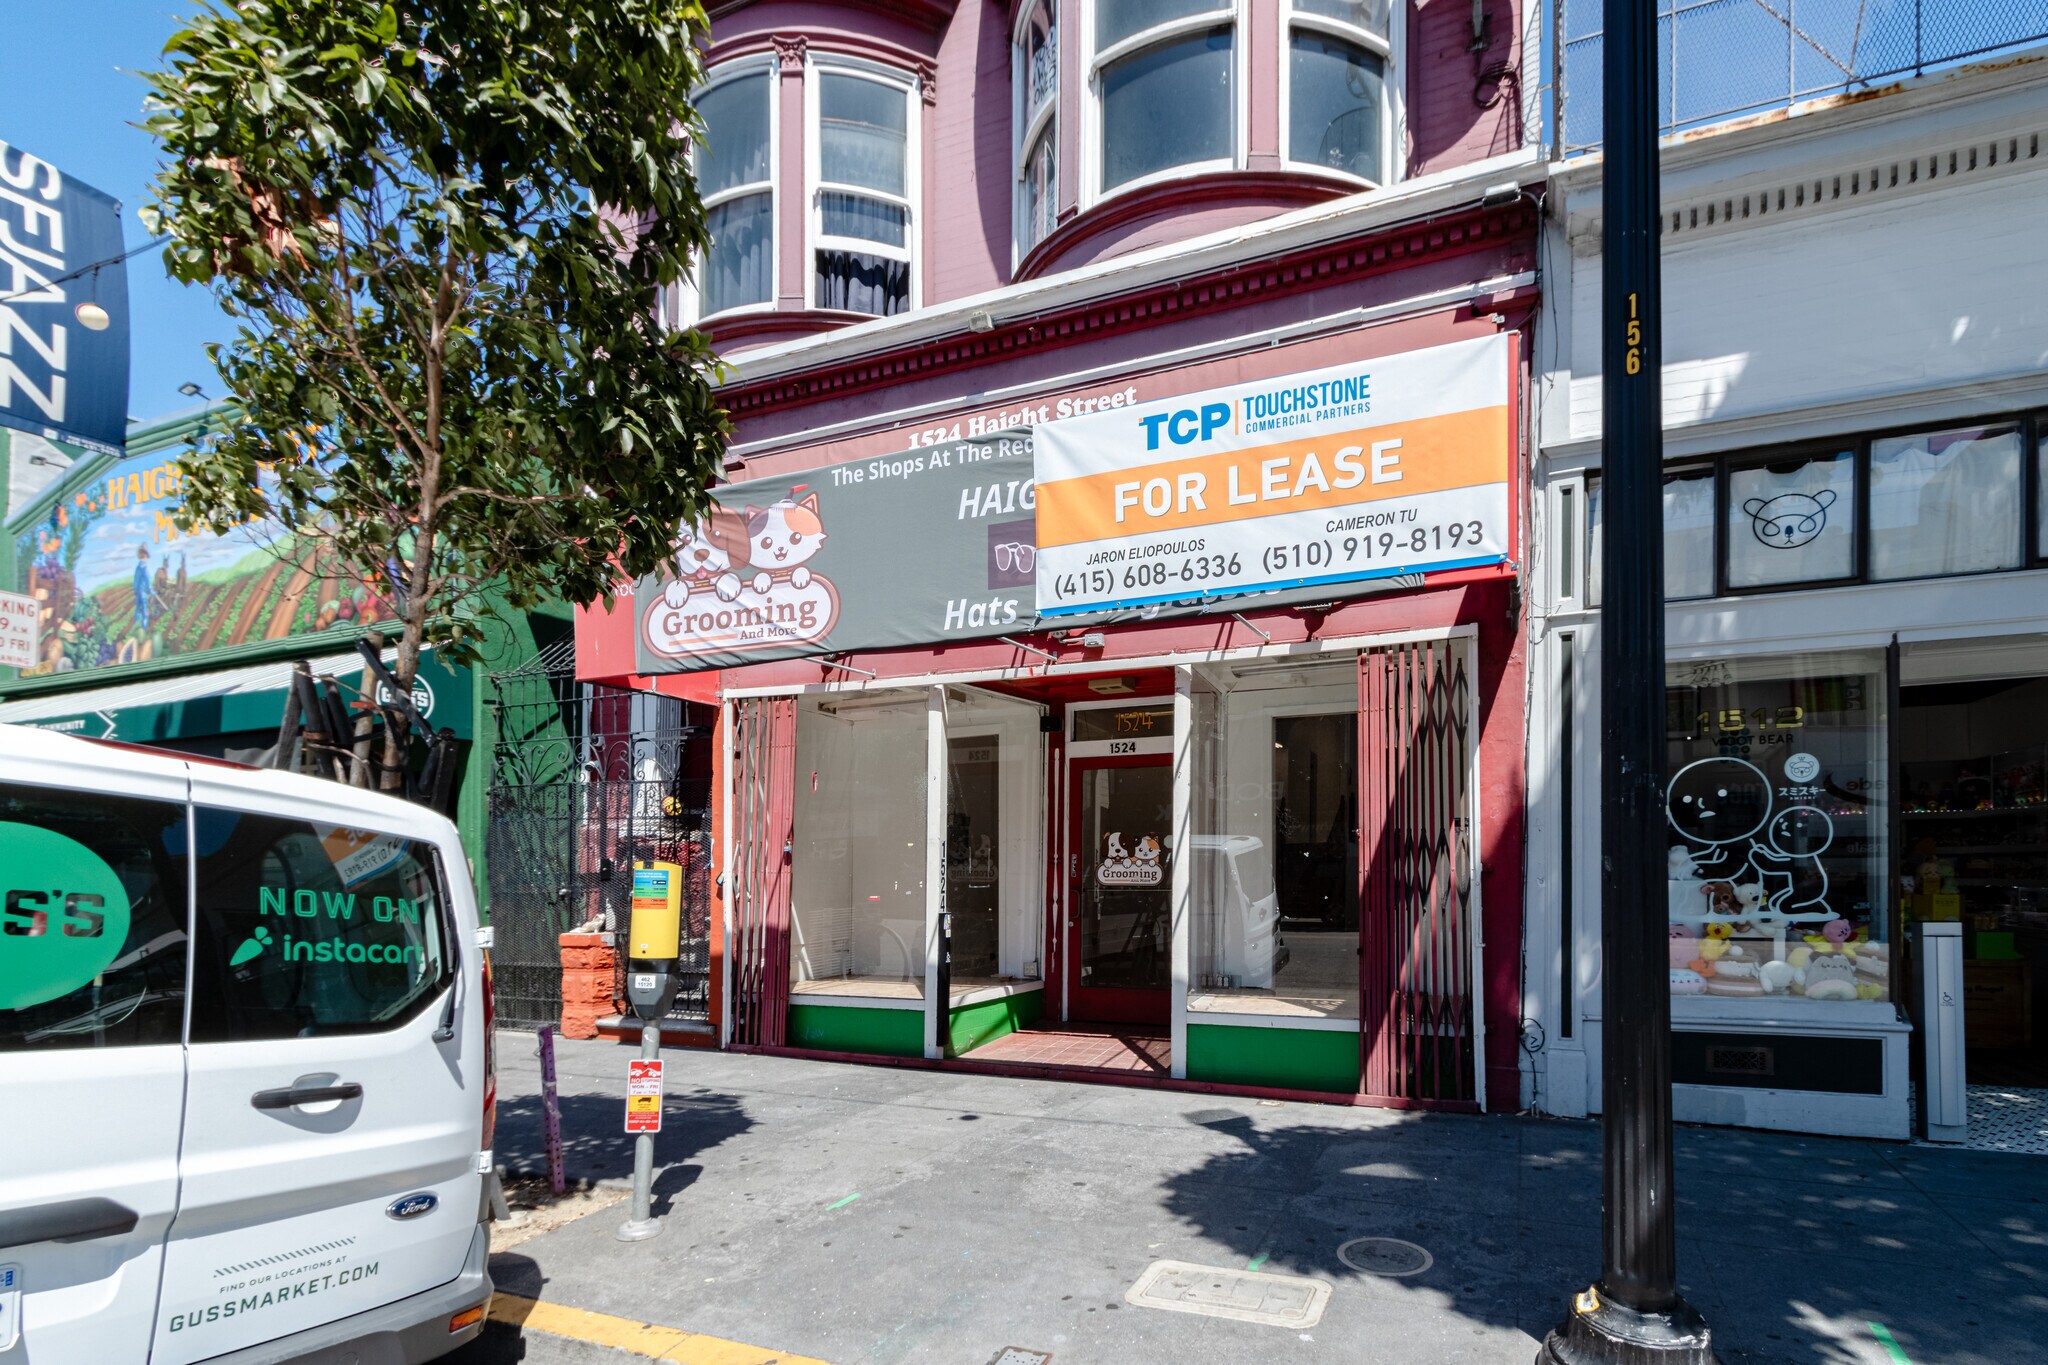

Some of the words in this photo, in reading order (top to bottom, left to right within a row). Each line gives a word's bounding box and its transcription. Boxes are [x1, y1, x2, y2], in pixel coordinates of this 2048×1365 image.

[0, 140, 67, 423] SFJAZZ
[1626, 292, 1641, 375] 156
[1243, 374, 1370, 420] TOUCHSTONE
[908, 426, 961, 450] 1524
[967, 403, 1049, 437] Haight
[1056, 386, 1137, 419] Street
[1139, 402, 1231, 451] TCP
[1246, 413, 1312, 434] COMMERCIAL
[1316, 402, 1370, 421] PARTNERS
[832, 467, 864, 487] The
[869, 457, 924, 480] Shops
[929, 450, 950, 470] At
[956, 444, 992, 464] The
[1114, 471, 1208, 523] FOR
[1229, 437, 1404, 507] LEASE
[1326, 512, 1396, 533] CAMERON
[1399, 508, 1418, 523] TU
[1086, 549, 1126, 566] JARON
[1128, 538, 1206, 562] ELIOPOULOS
[1262, 539, 1333, 573] (510)
[1343, 519, 1484, 561] 919-8193
[1055, 569, 1115, 600] (415)
[1123, 552, 1242, 589] 608-6336
[663, 597, 818, 636] Grooming
[943, 597, 1018, 630] Hats
[10, 639, 30, 652] FRI
[740, 628, 764, 640] And
[767, 627, 797, 637] More
[1115, 711, 1154, 732] 1524
[1696, 706, 1805, 733] 1512
[1110, 742, 1137, 755] 1524
[1759, 734, 1794, 745] BEAR
[1778, 786, 1827, 796] スミスキー
[939, 840, 948, 912] 1524
[1102, 868, 1158, 881] Grooming
[260, 886, 356, 920] NOW
[373, 896, 419, 925] ON
[283, 934, 424, 964] instacart
[401, 1199, 430, 1215] Ford
[219, 1281, 246, 1295] FIND
[249, 1275, 272, 1288] OUR
[275, 1259, 332, 1281] LOCATIONS
[335, 1255, 347, 1265] AT
[169, 1261, 380, 1333] GUSSMARKET.COM
